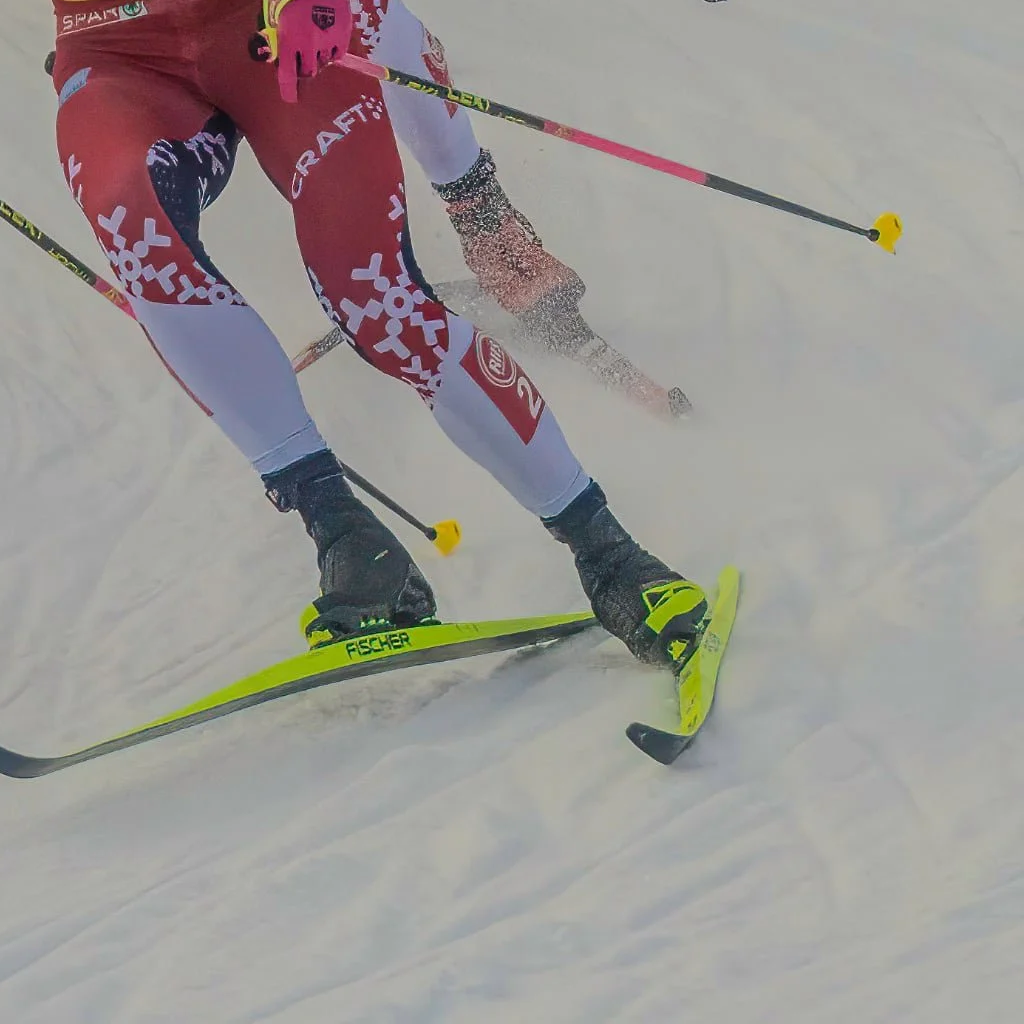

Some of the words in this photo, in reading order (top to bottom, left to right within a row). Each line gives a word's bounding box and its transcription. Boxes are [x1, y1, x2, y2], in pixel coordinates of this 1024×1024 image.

[291, 102, 368, 200] CRAFT
[517, 376, 543, 420] 2
[345, 631, 413, 660] FISCHER
